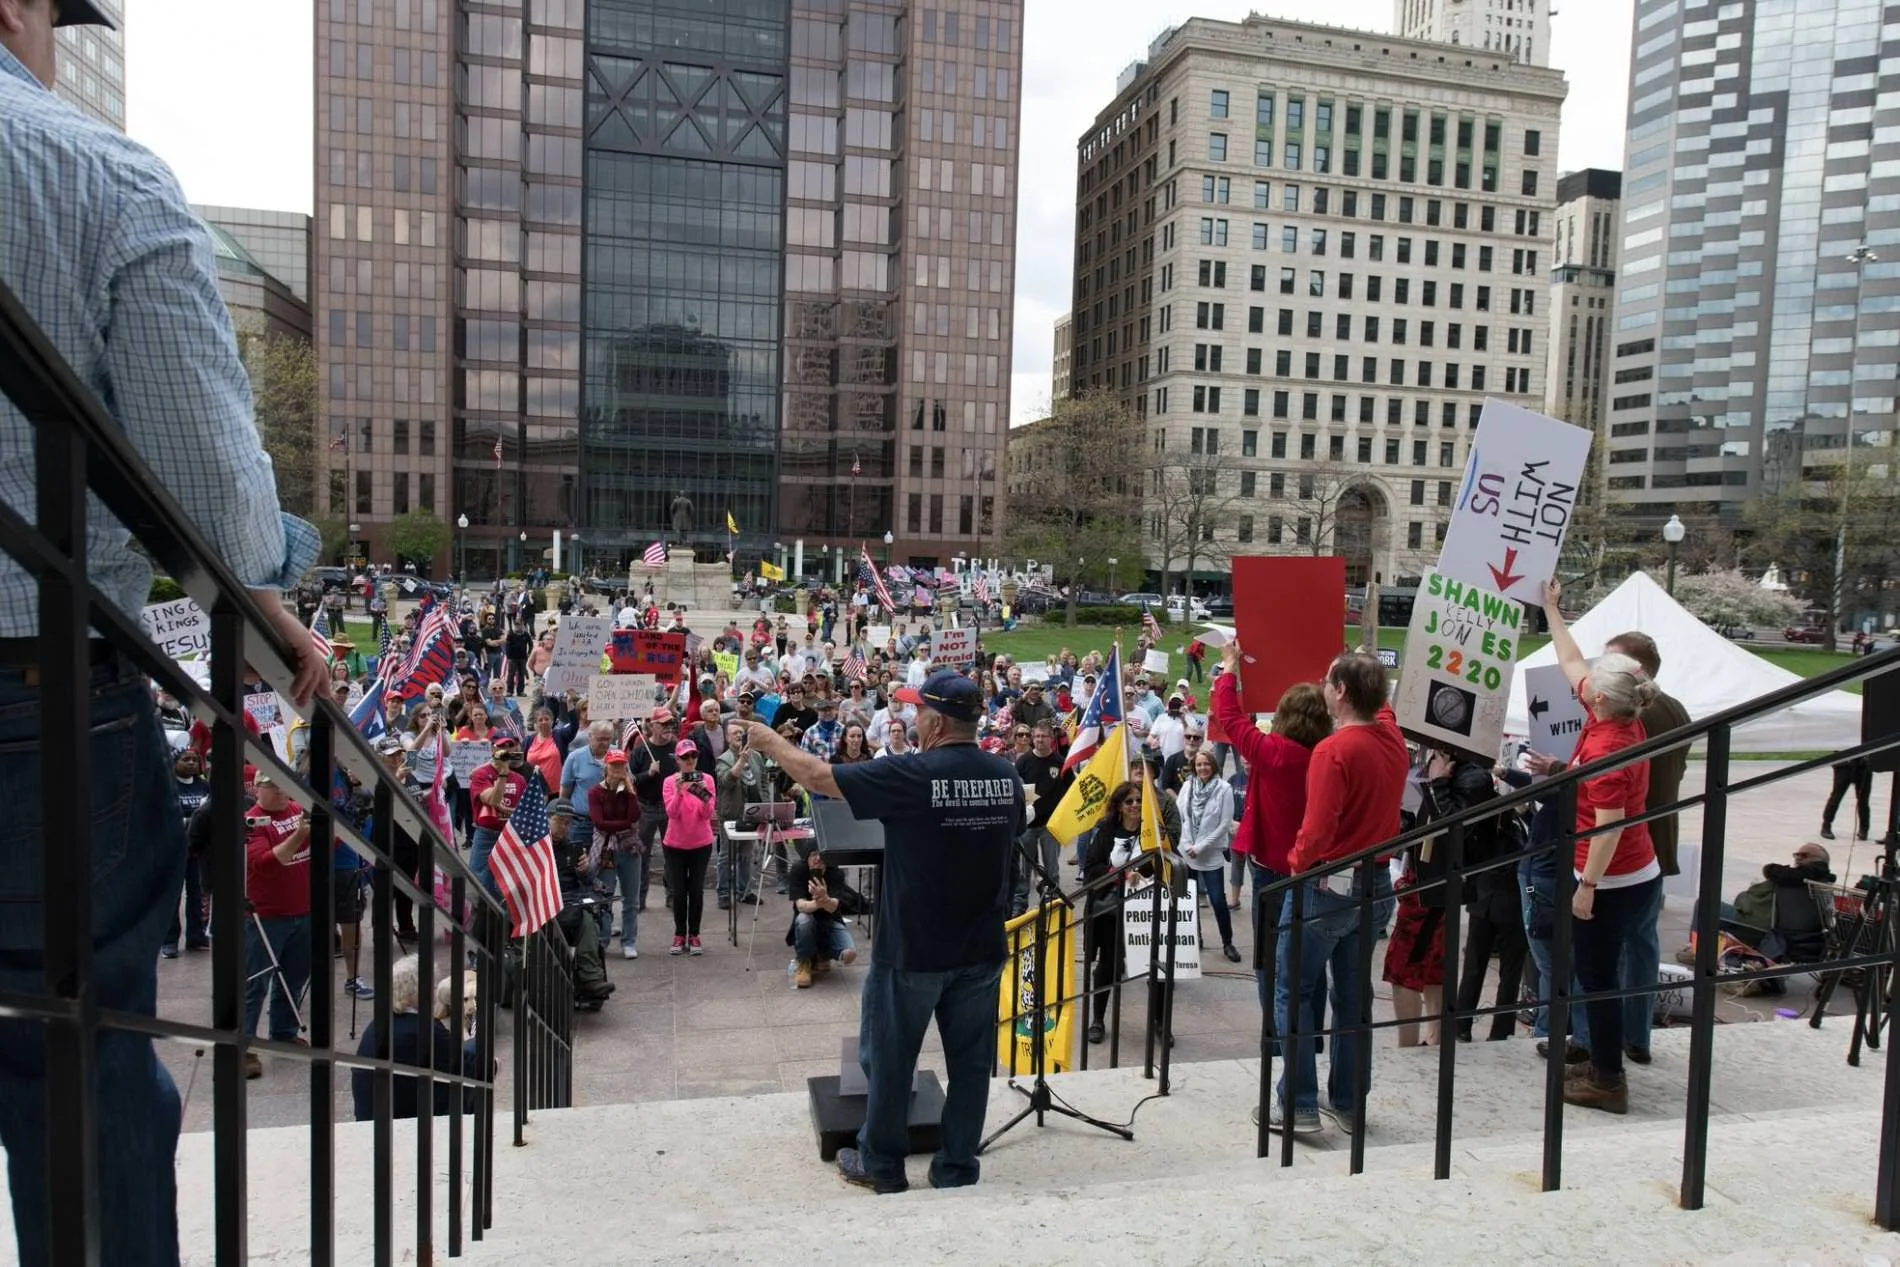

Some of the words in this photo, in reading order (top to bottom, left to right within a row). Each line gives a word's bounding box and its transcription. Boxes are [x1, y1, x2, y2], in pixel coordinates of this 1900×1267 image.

[1470, 473, 1505, 517] US
[1500, 460, 1550, 545] WITH
[1536, 481, 1575, 547] NOT
[1428, 572, 1520, 630] SHAWN
[155, 615, 199, 634] KINGS
[1446, 603, 1496, 631] KELLY
[158, 633, 212, 656] JESU
[944, 631, 965, 639] I'm
[939, 641, 969, 651] NOT
[932, 652, 974, 664] Afraid
[1426, 644, 1501, 690] 2220
[246, 693, 272, 706] STOP
[1550, 719, 1582, 736] WITH
[931, 779, 949, 799] BE
[953, 778, 1014, 798] PREPARED
[1126, 910, 1193, 922] PROFUDLY
[1128, 933, 1195, 946] Anti-oan
